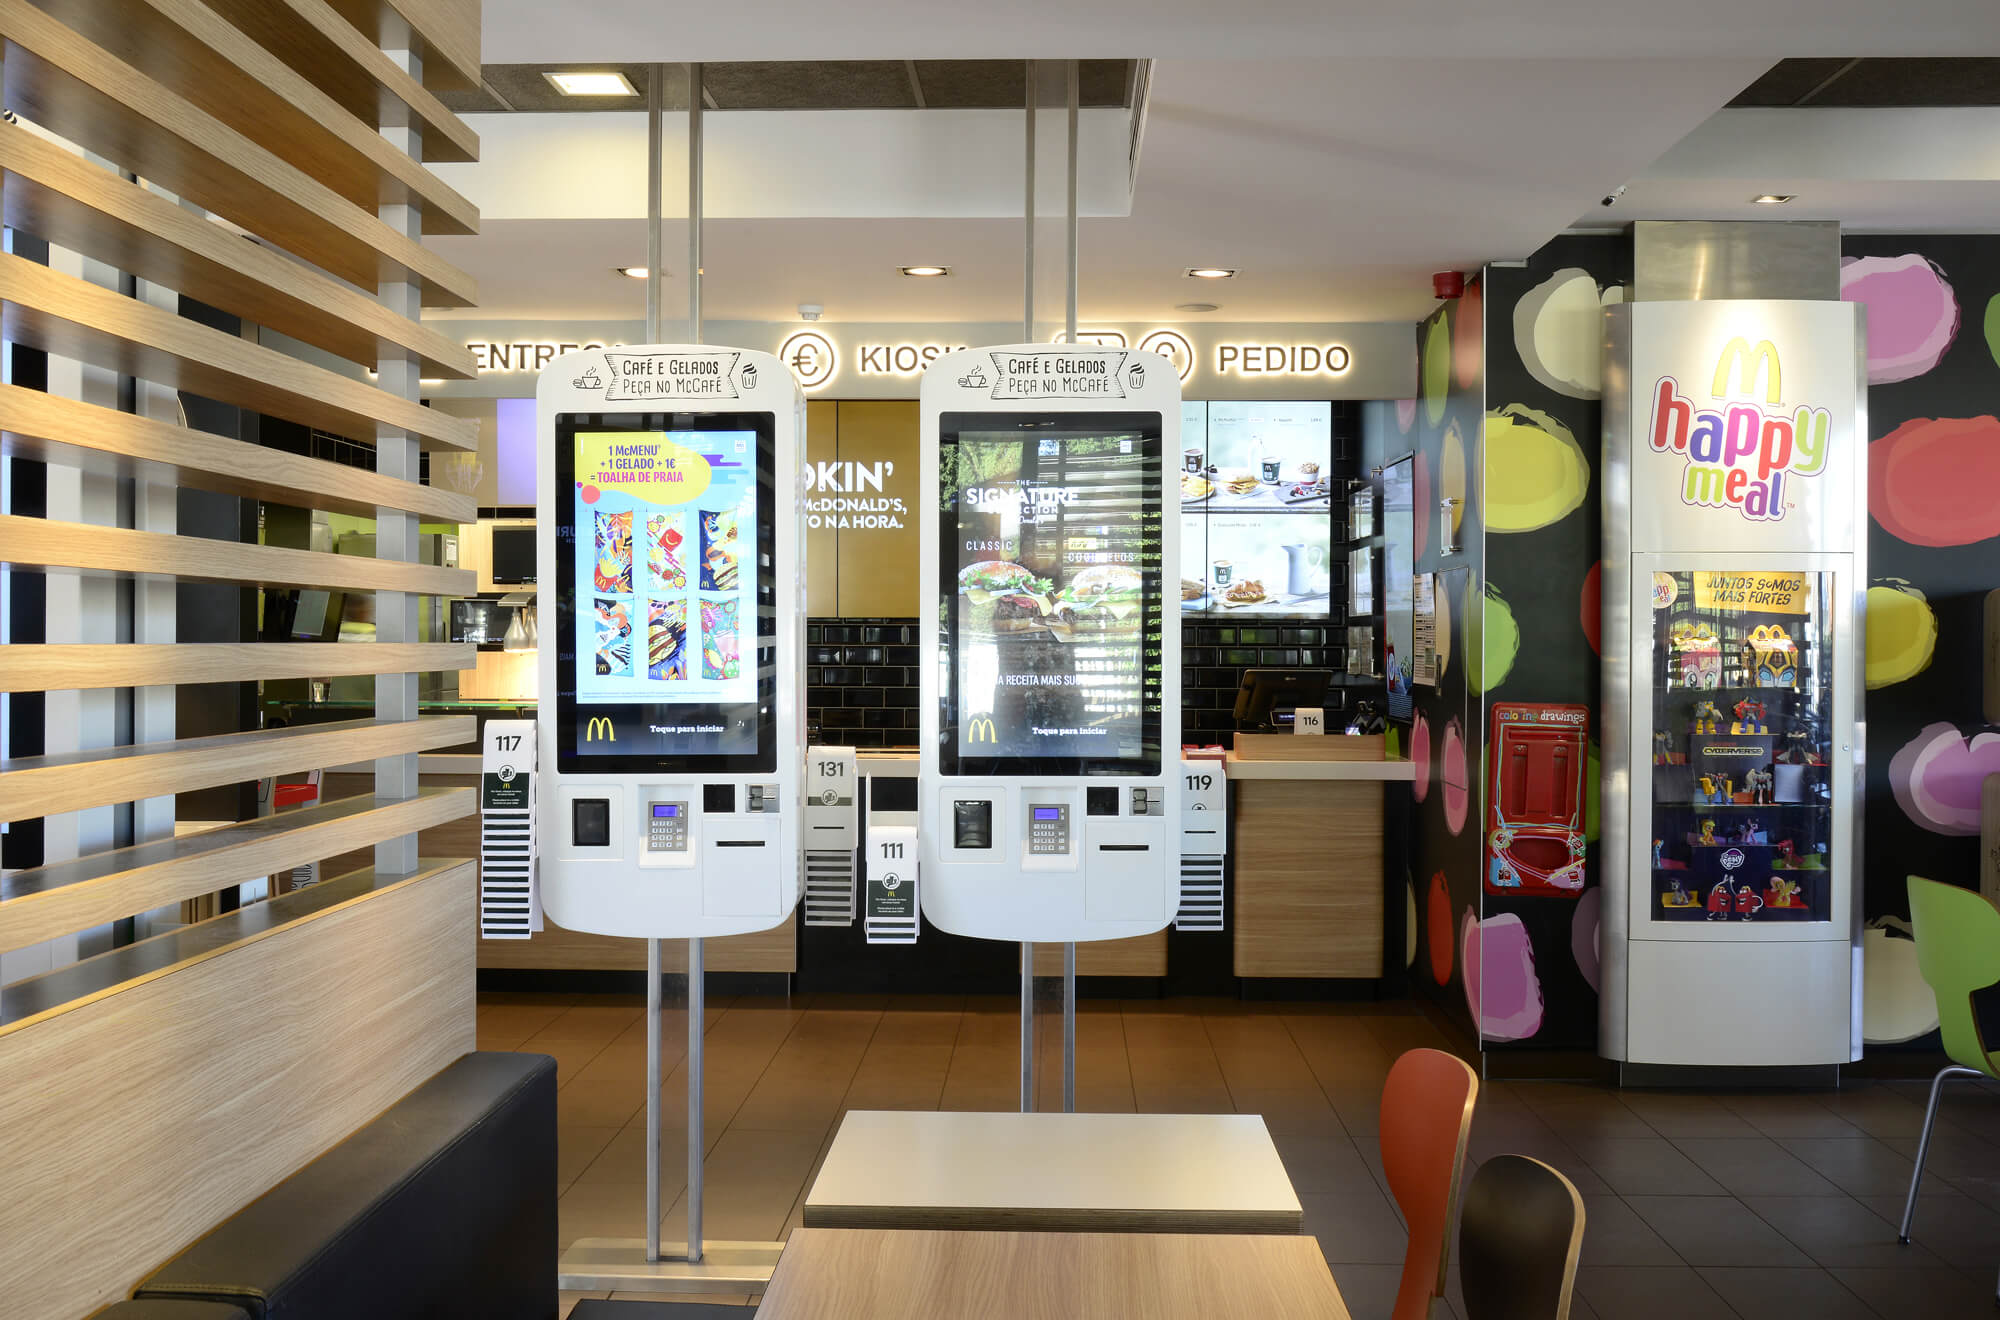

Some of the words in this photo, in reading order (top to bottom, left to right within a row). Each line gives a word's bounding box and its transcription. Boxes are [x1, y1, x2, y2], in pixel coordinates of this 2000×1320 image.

[467, 344, 624, 370] ENTR
[861, 346, 967, 372] KIOS
[1219, 345, 1350, 372] PEDIDO
[656, 379, 671, 393] NO
[1043, 378, 1057, 393] NO
[1652, 379, 1830, 481] happy
[616, 458, 654, 470] GELADO
[597, 472, 636, 483] TOALHA
[638, 472, 651, 483] DE
[653, 472, 684, 483] PRAIA
[1685, 466, 1783, 517] meal
[825, 515, 850, 529] NA
[853, 515, 904, 529] HORA.
[966, 541, 1013, 551] CLASSIC
[1714, 590, 1745, 603] MAIS
[1748, 591, 1791, 606] FORTES
[1006, 675, 1039, 686] RECEITA
[1041, 675, 1062, 685] MAIS
[1303, 716, 1319, 726] 116
[1540, 710, 1585, 724] drawings
[650, 725, 675, 734] Toque
[677, 726, 696, 734] para
[697, 725, 724, 733] iniciar
[1032, 727, 1057, 736] Toque
[1059, 728, 1078, 736] para
[1080, 727, 1107, 735] iniciar
[495, 736, 521, 751] 117
[818, 761, 844, 777] 131
[1186, 775, 1212, 791] 119
[881, 843, 904, 859] 111
